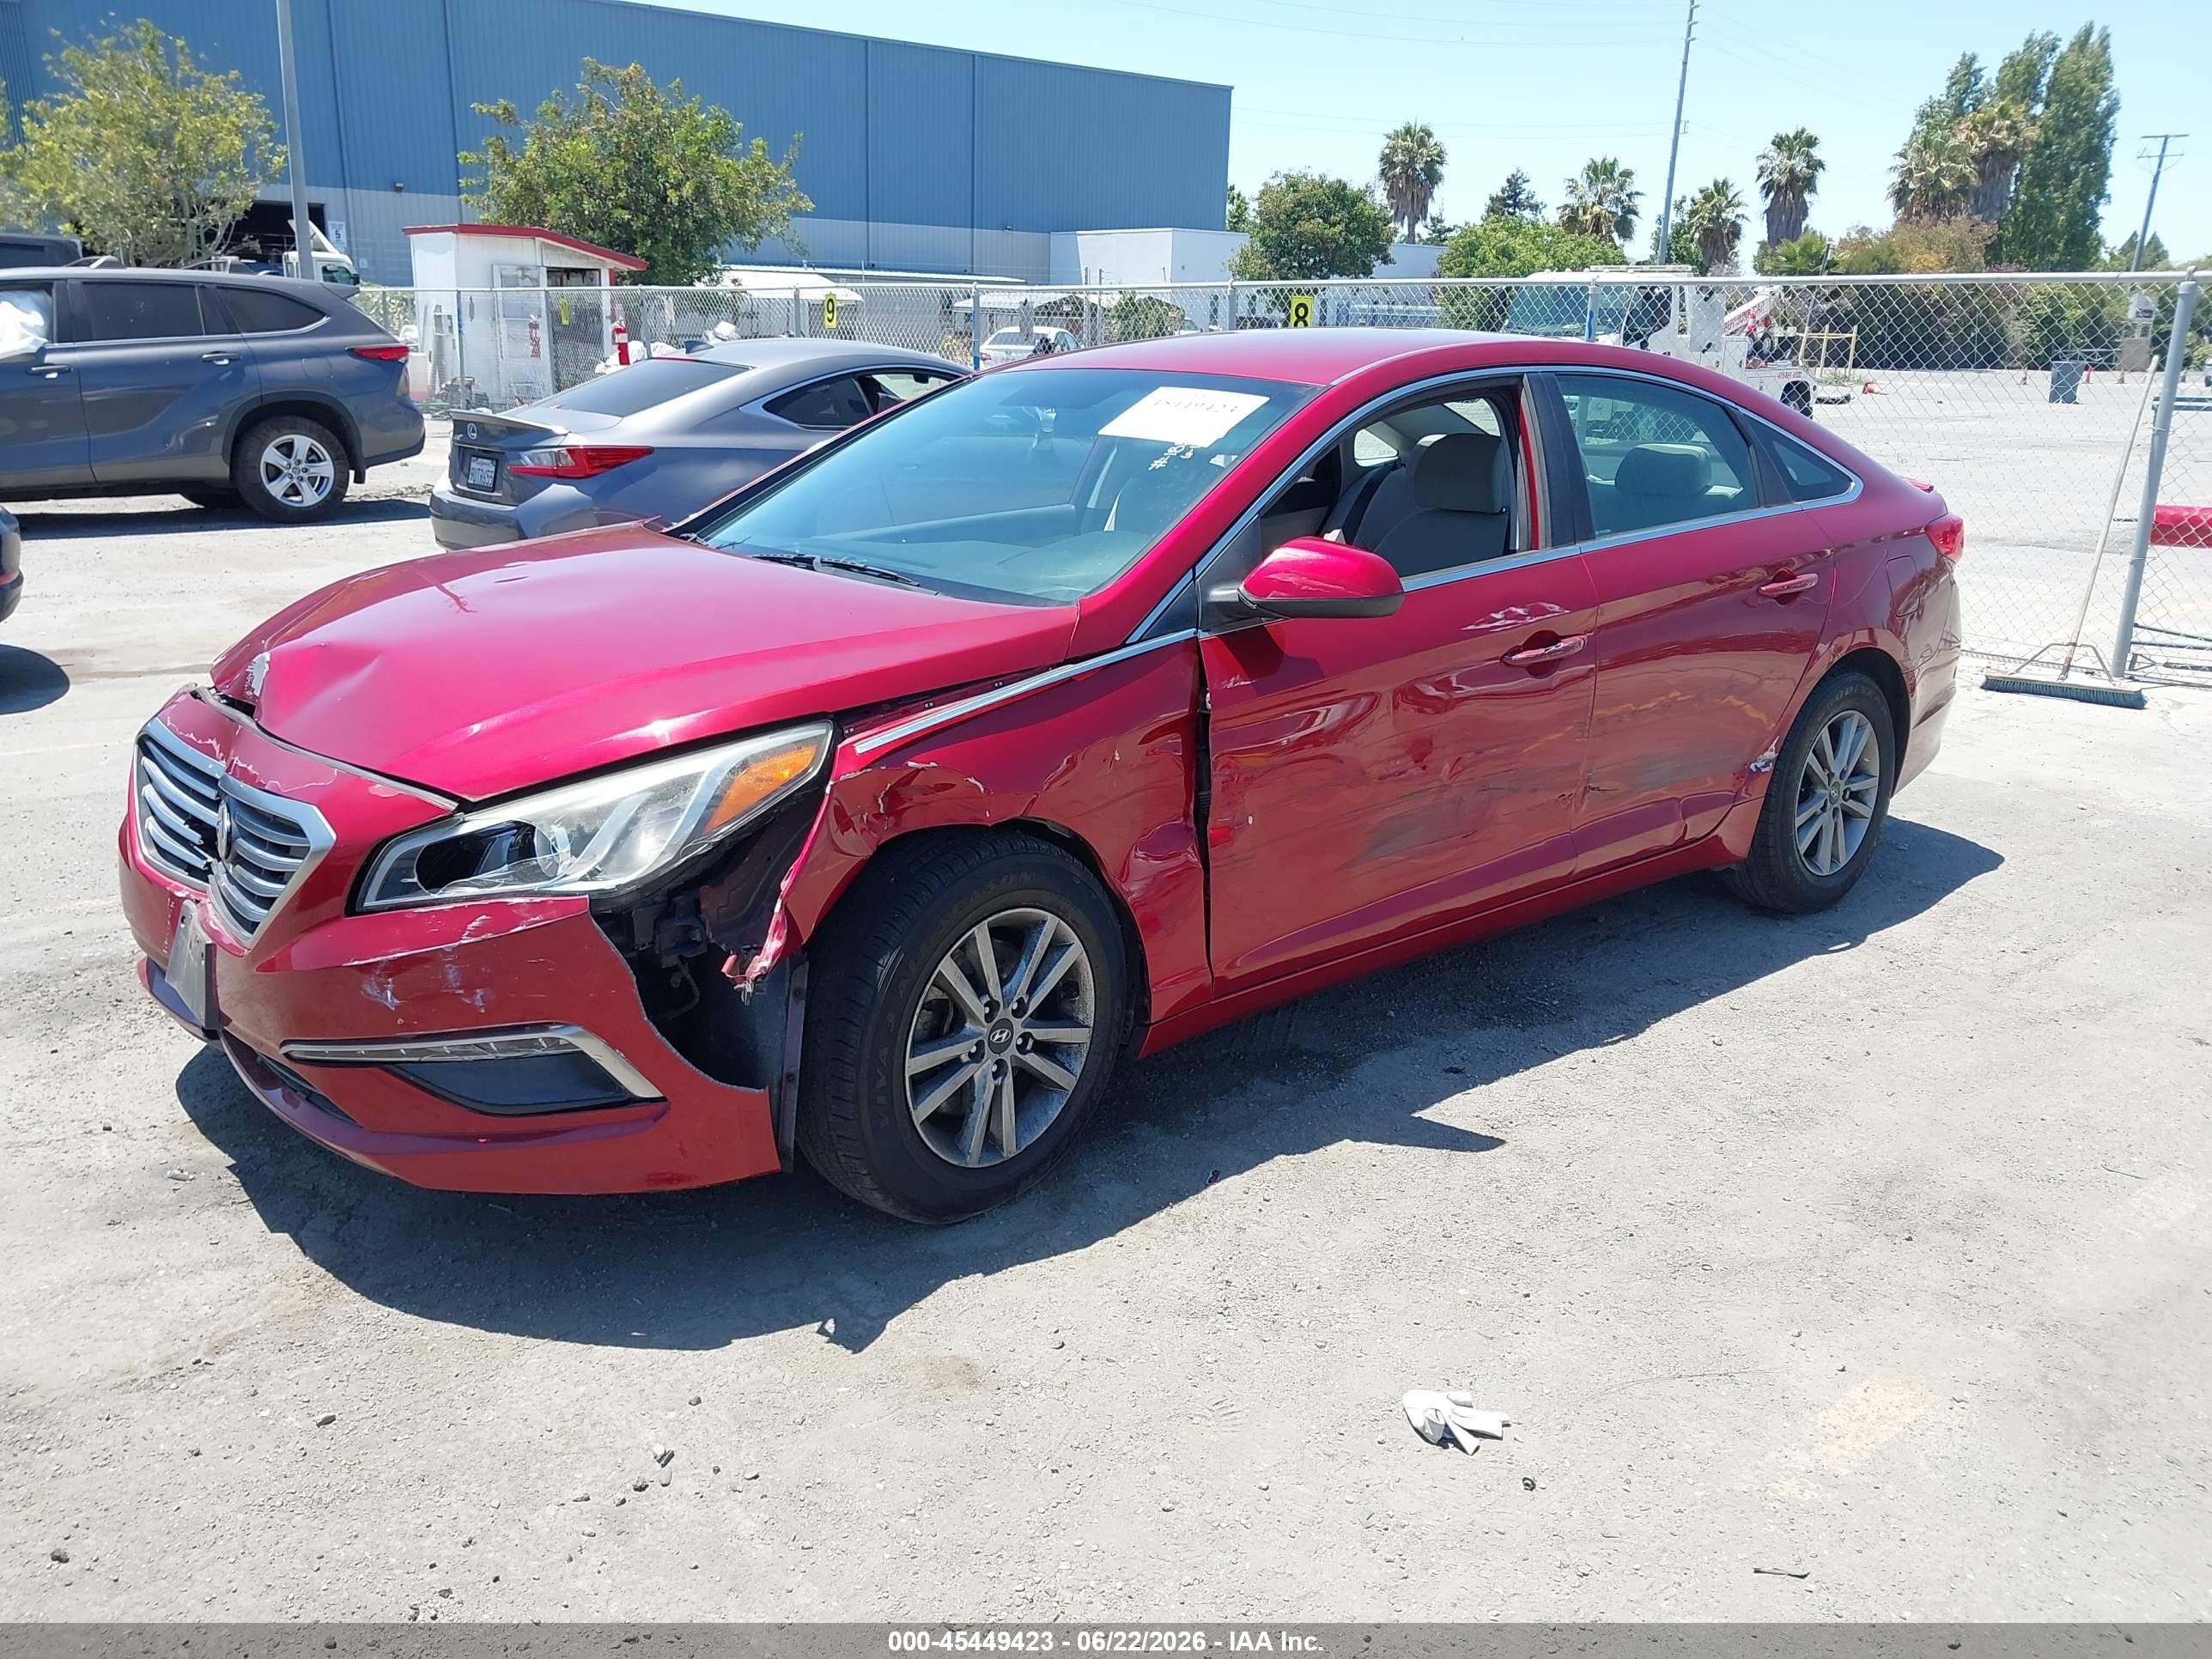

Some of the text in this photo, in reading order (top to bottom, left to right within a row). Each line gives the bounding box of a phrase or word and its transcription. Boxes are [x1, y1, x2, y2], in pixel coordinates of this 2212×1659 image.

[335, 229, 342, 239] 5
[826, 298, 835, 323] 9
[1293, 302, 1309, 327] 8
